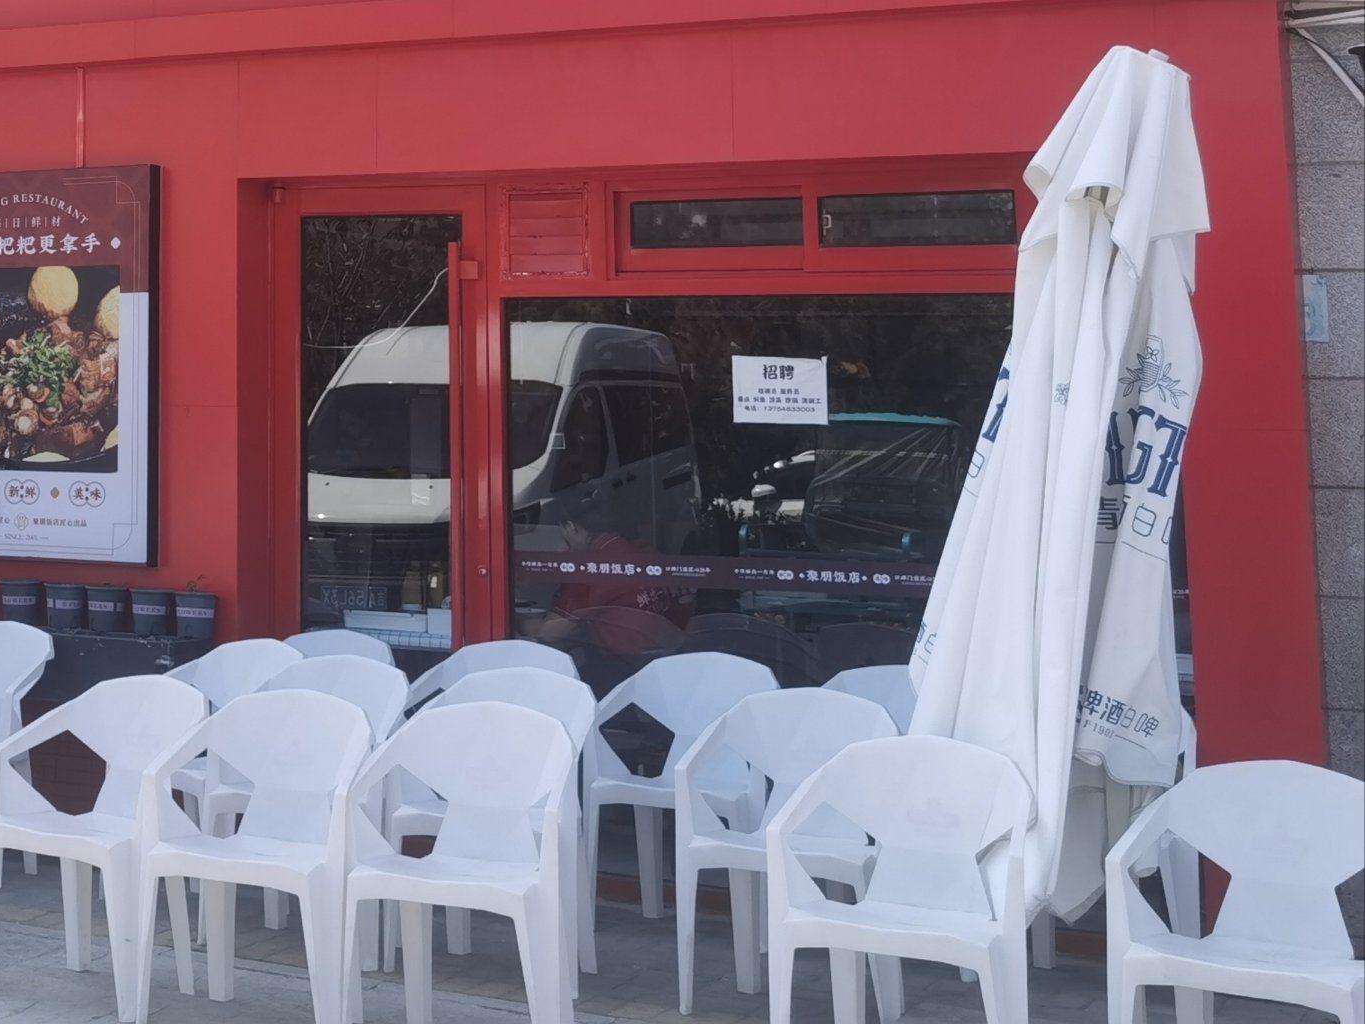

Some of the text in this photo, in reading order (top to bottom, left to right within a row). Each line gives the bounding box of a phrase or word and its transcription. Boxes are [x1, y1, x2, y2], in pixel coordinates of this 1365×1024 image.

[13, 193, 89, 224] RESTAURANT
[762, 364, 795, 380] 招聘
[8, 485, 36, 498] 新鲜
[72, 486, 102, 500] 美味
